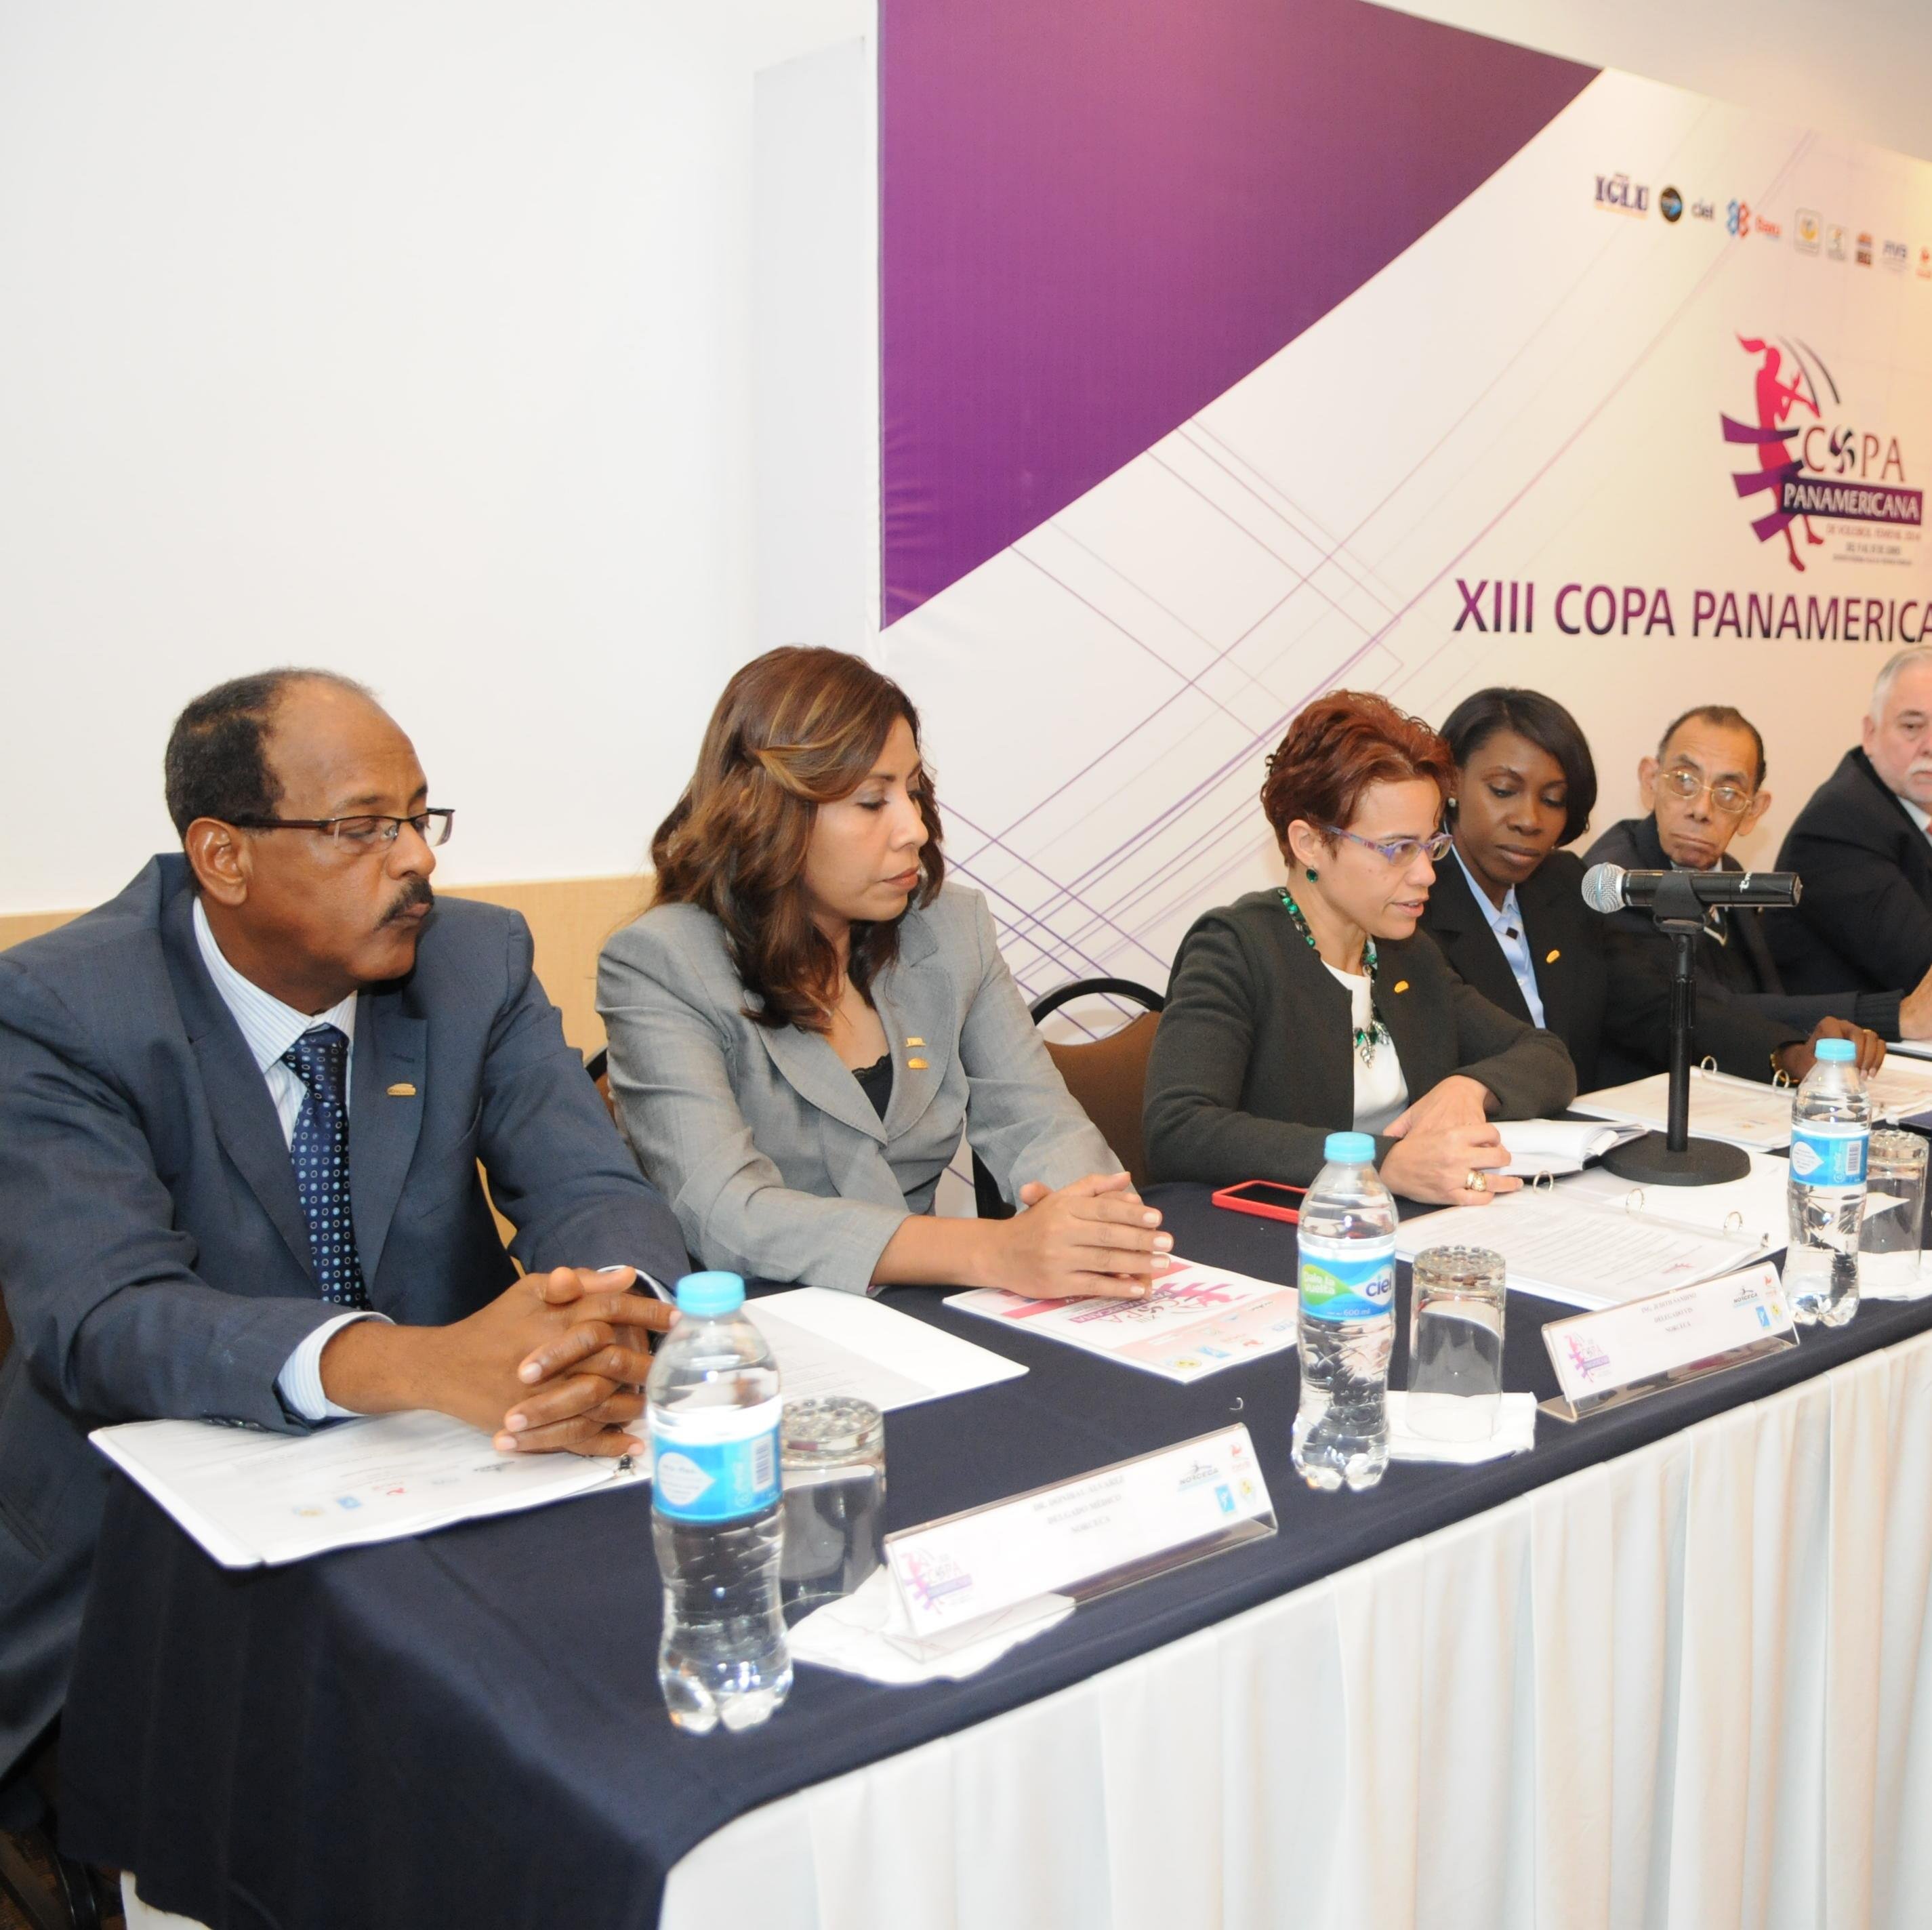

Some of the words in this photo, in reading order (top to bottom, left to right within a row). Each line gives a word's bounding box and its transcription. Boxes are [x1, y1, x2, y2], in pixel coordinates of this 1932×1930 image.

[1784, 482, 1920, 520] PANAMERICANA
[1454, 579, 1534, 633] XIII
[1554, 583, 1676, 638] COPA
[1365, 1271, 1393, 1297] ciel
[1344, 1309, 1359, 1317] 600
[1180, 1468, 1218, 1485] NORCECA
